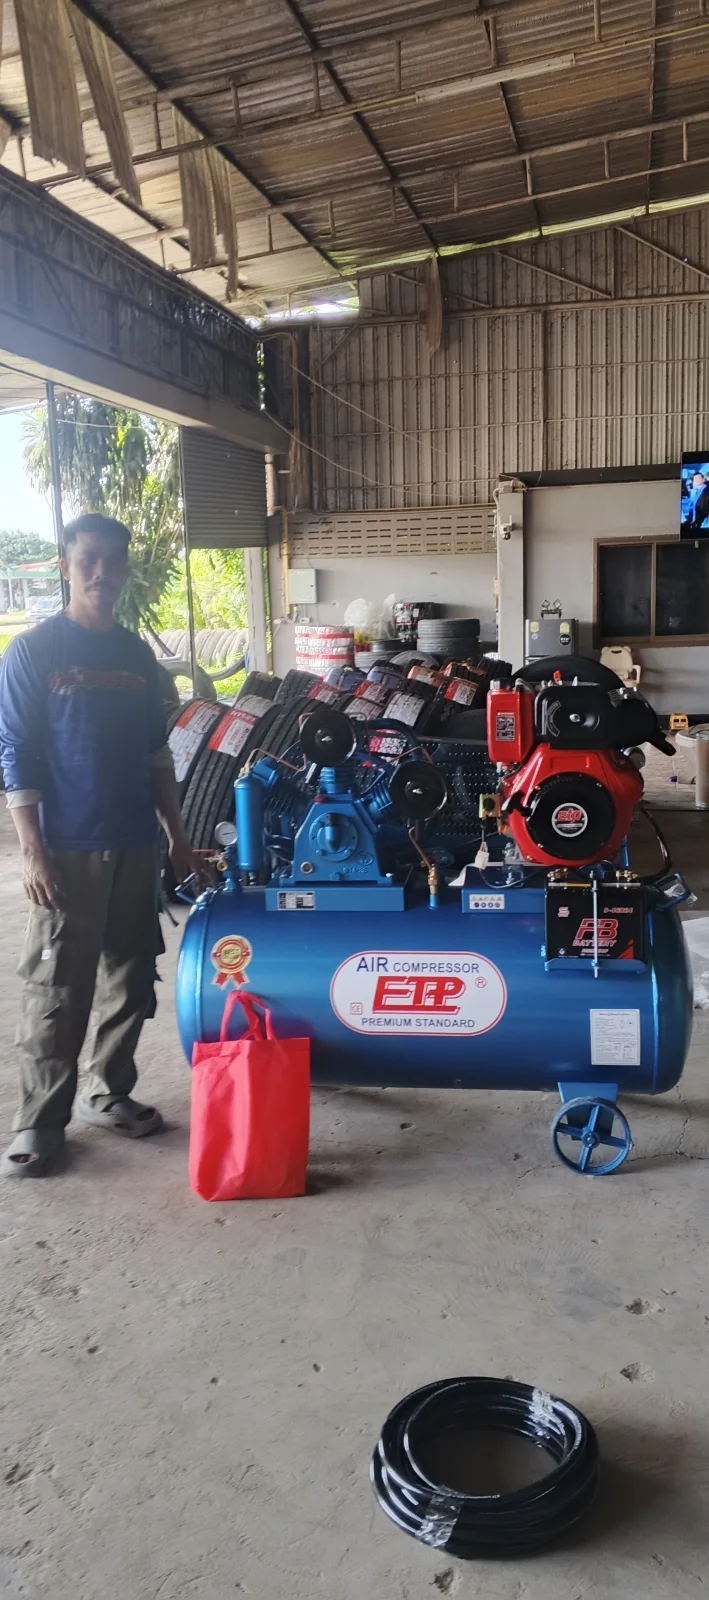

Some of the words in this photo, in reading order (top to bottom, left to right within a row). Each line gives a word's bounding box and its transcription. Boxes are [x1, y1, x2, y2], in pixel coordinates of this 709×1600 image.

[572, 939, 617, 947] BATTERY
[356, 957, 389, 973] AIR
[393, 962, 480, 974] COMPRESSOR
[372, 976, 466, 1015] ETP
[361, 1017, 412, 1027] PREMIUM
[415, 1018, 475, 1028] STANDARD
